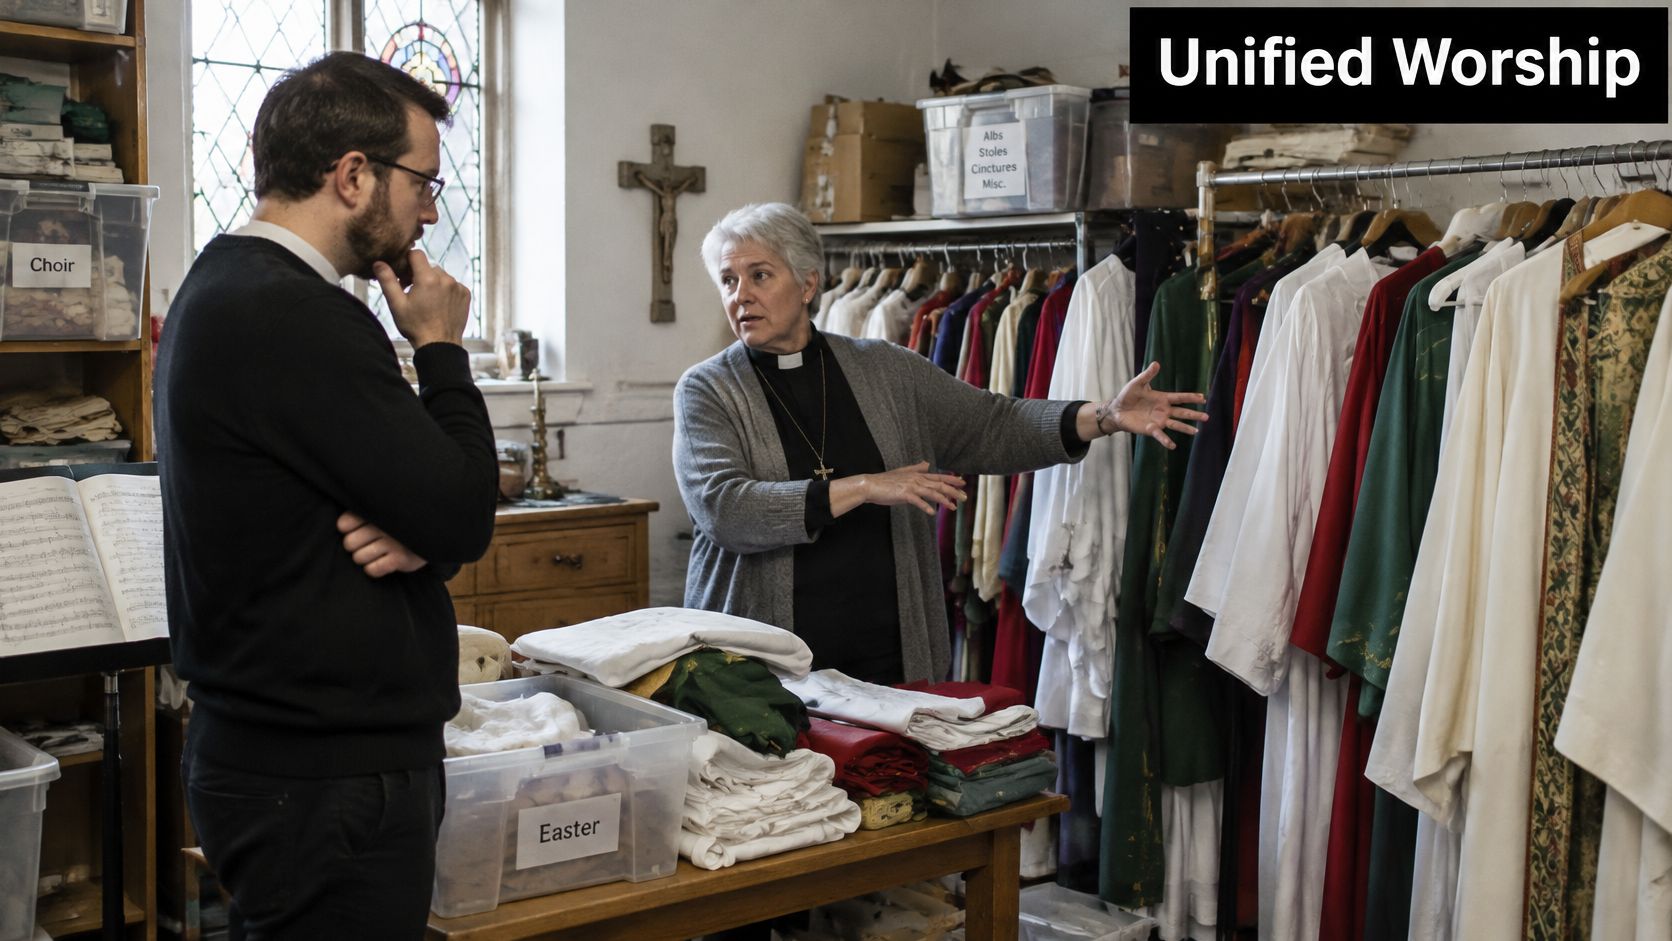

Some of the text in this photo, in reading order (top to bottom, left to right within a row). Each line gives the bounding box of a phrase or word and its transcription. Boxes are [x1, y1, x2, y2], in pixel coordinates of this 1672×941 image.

[983, 130, 1004, 142] Albs
[979, 146, 1008, 157] Stoles
[971, 163, 1017, 174] Cinctures
[983, 179, 1007, 189] Misc.
[30, 257, 75, 272] Choir
[539, 820, 600, 843] Easter
